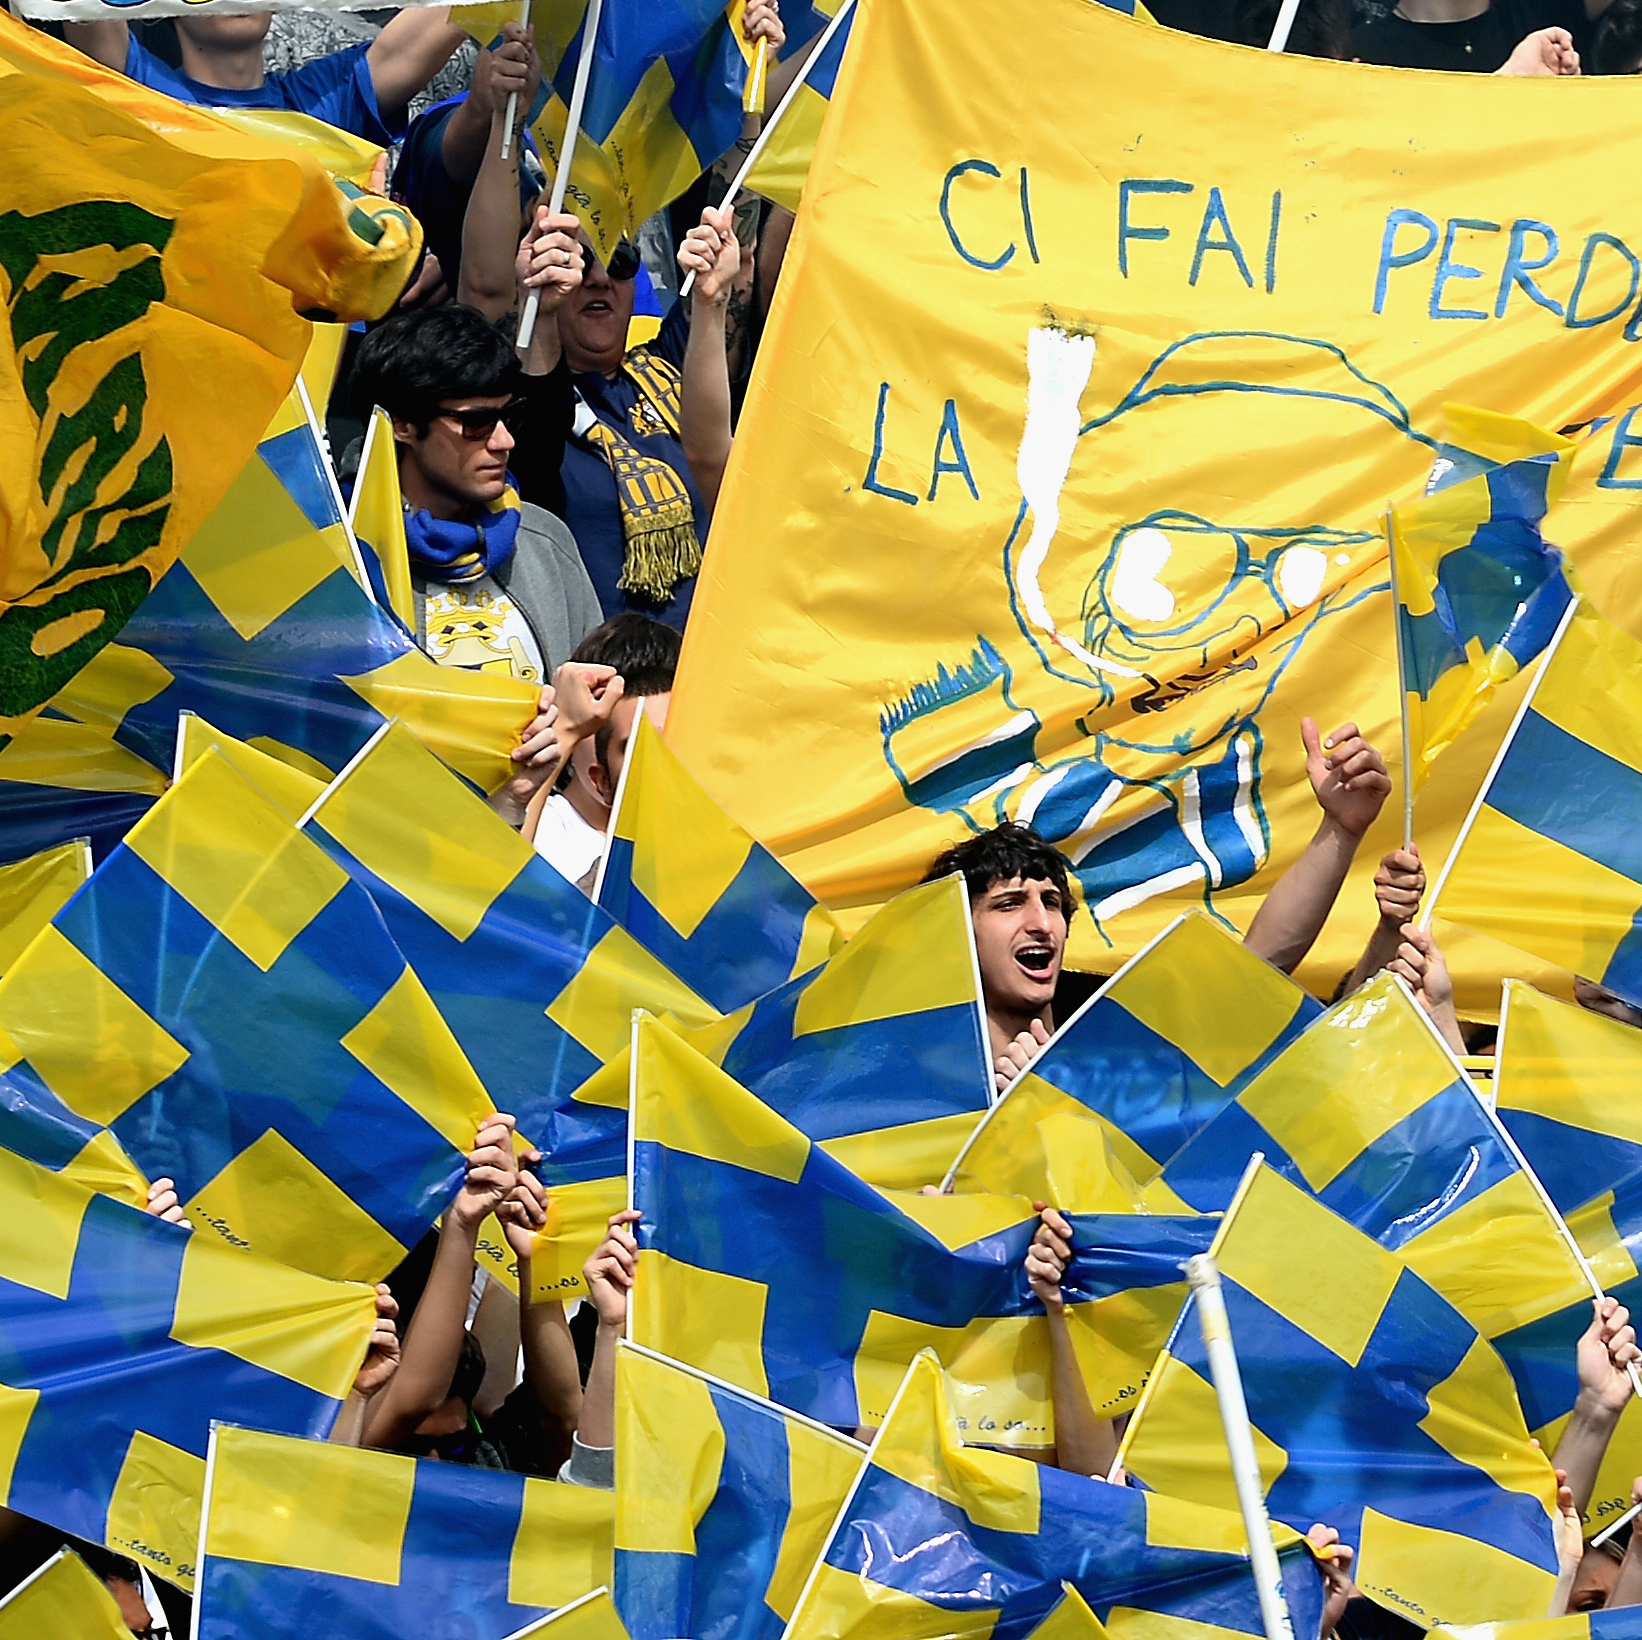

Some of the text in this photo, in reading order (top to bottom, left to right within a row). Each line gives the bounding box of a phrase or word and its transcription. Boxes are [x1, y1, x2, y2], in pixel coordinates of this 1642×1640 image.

[939, 158, 1041, 272] CI
[1117, 176, 1283, 295] FAI
[860, 380, 981, 506] LA
[195, 1206, 251, 1252] ...tant
